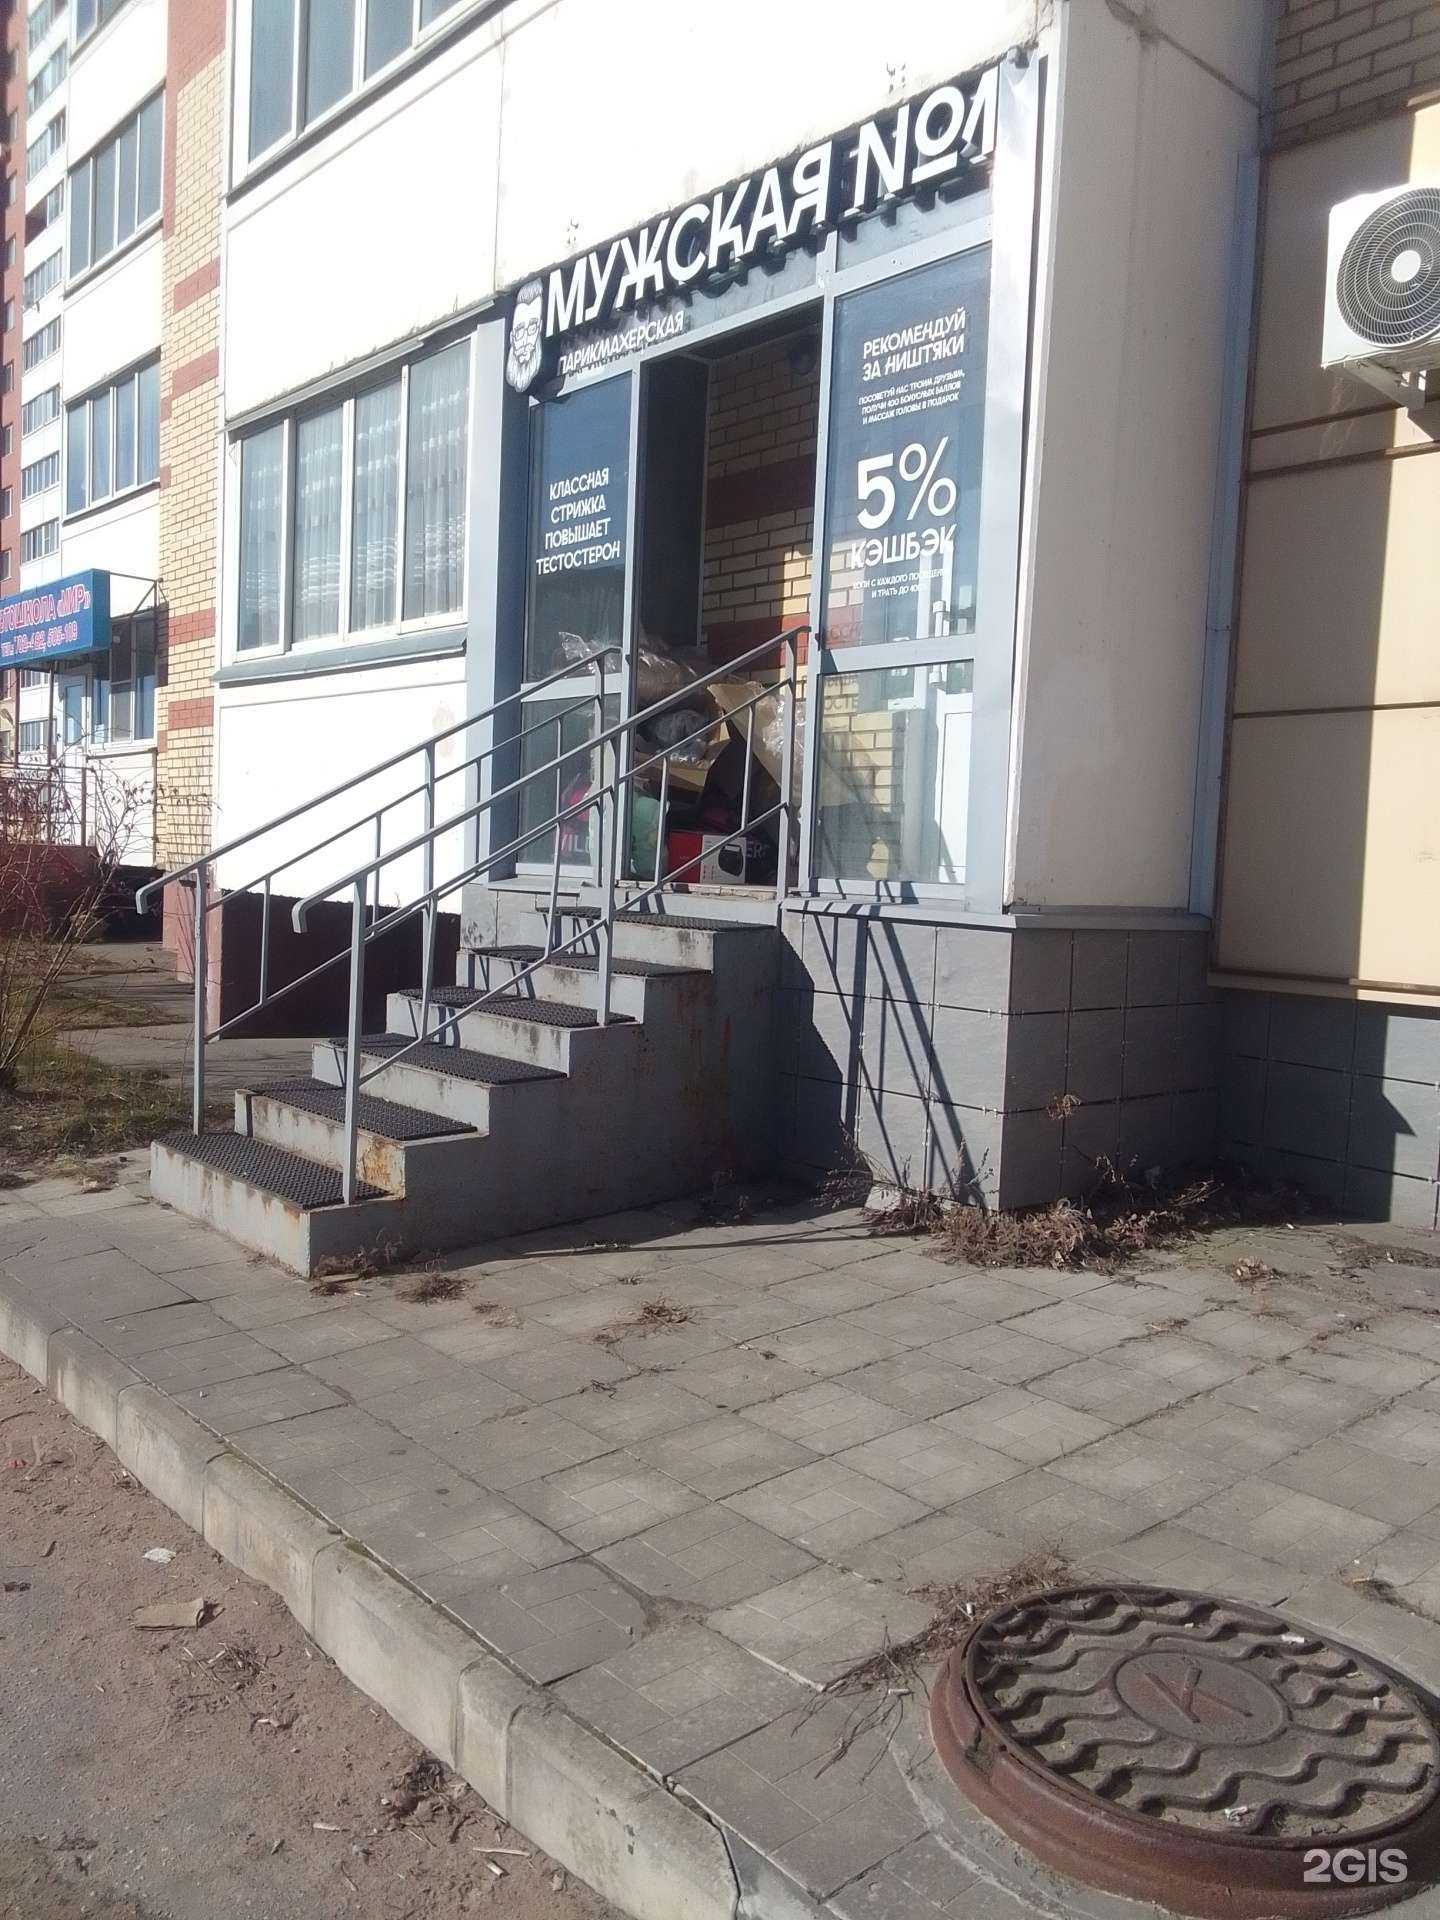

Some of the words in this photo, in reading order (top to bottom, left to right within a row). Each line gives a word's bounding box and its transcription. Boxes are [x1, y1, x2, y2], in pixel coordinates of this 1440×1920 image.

[545, 141, 832, 338] МУЖСКАЯ
[557, 311, 685, 375] ПАРИКМАХЕРСКАЯ
[863, 306, 966, 360] РЕКОМЕНДУЙ
[862, 360, 882, 382] ЗА
[885, 333, 965, 376] НИШТЯКИ
[858, 387, 894, 405] ПОСОВЕТУЙ
[927, 391, 960, 408] ПОДАРОК
[549, 467, 610, 501] КЛАССНАЯ
[857, 435, 957, 530] 5%
[551, 494, 607, 524] СТРИЖКА
[545, 517, 611, 550] ПОВЫШАЕТ
[850, 523, 957, 570] КЭШБЭК
[536, 540, 621, 576] ТЕСТОСТЕРОН
